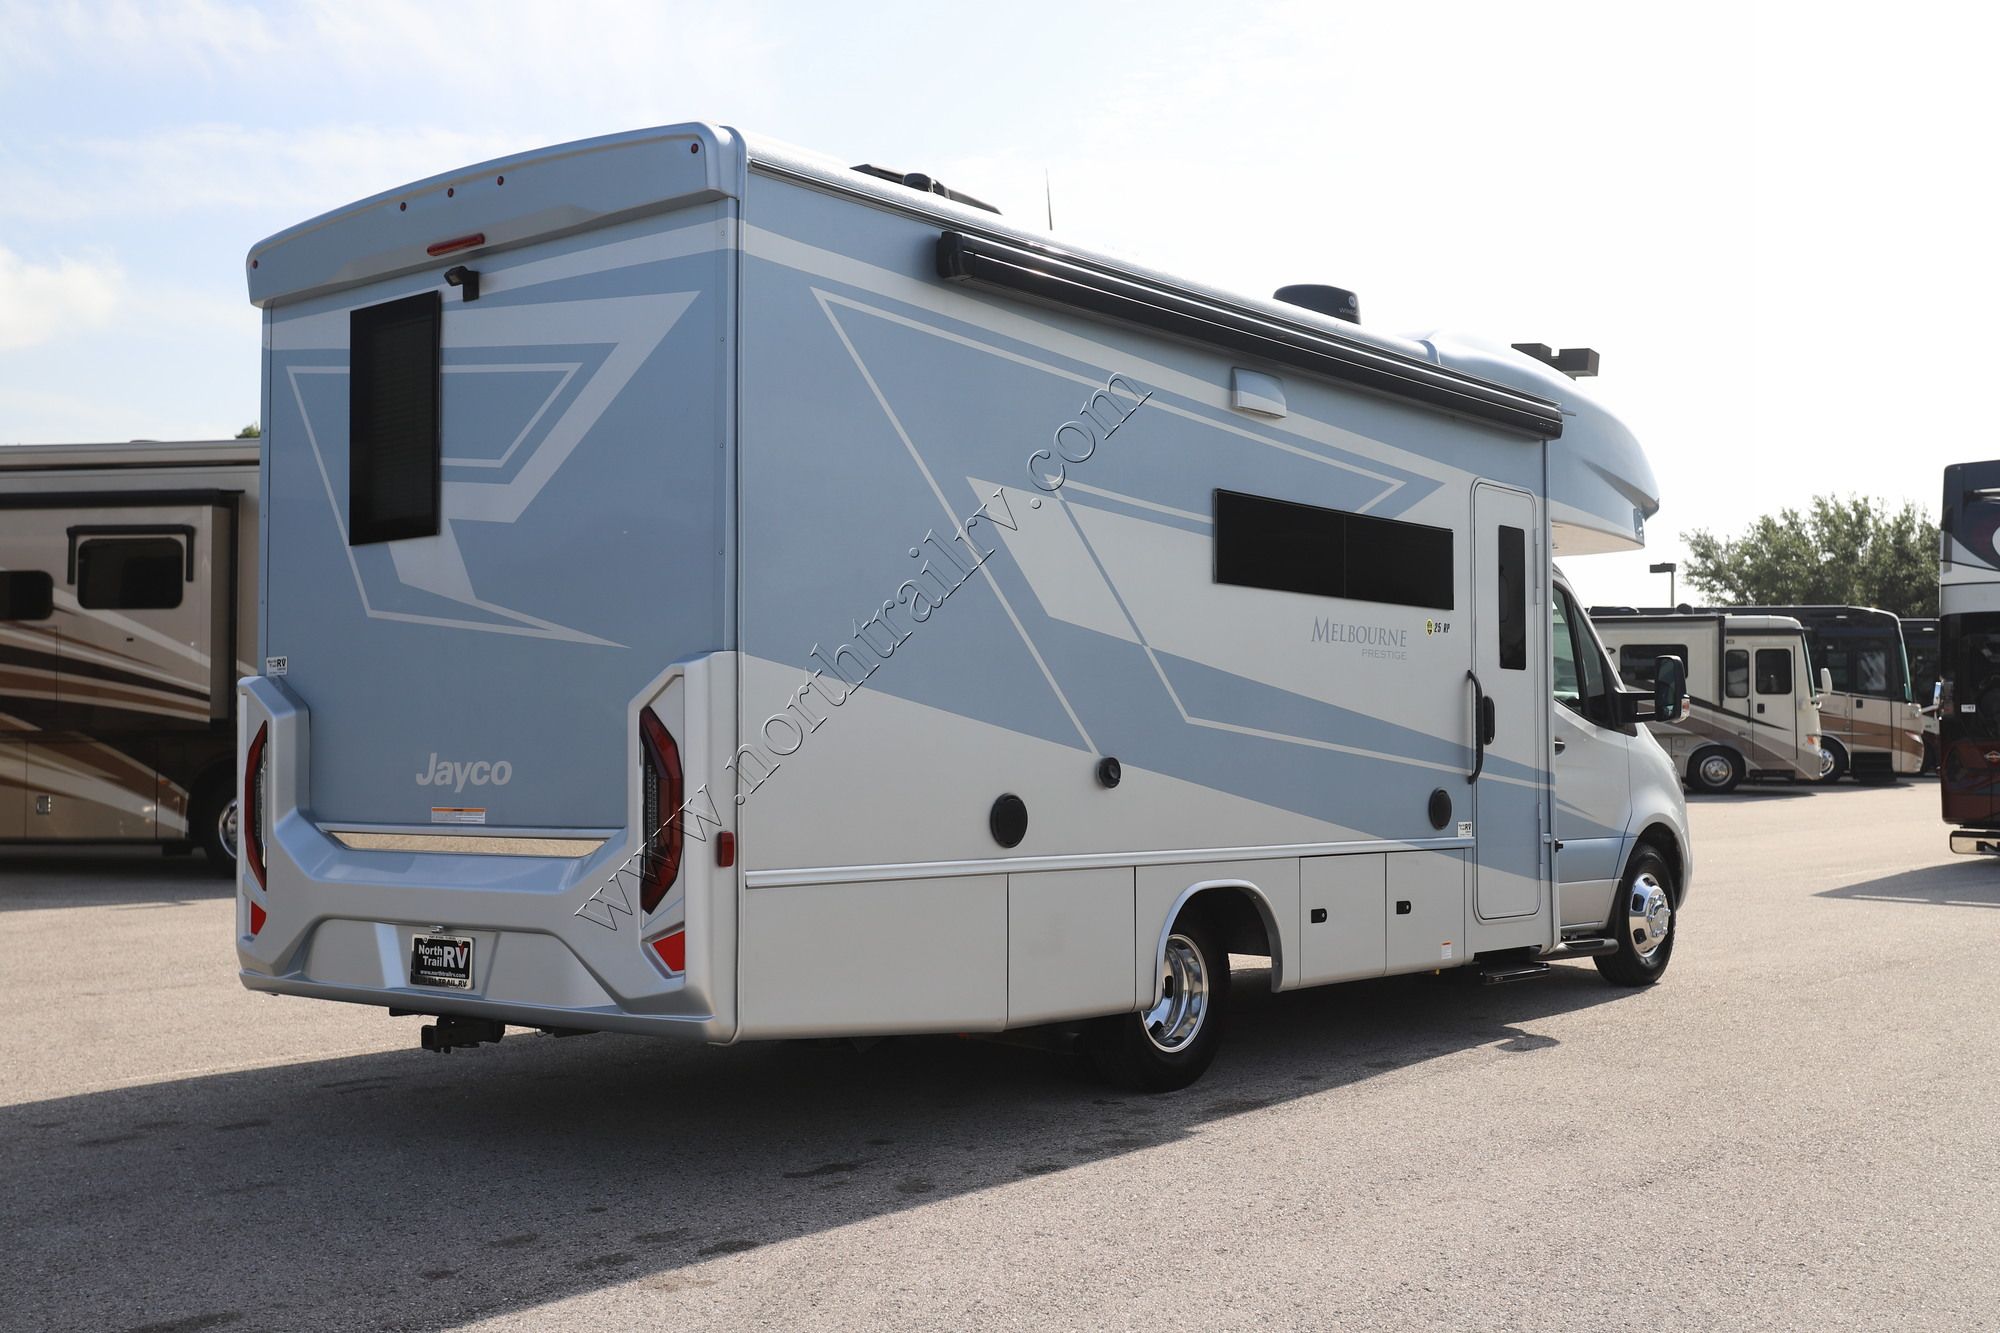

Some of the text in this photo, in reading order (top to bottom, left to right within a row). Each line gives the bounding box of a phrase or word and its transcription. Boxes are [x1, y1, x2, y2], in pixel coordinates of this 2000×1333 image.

[1361, 648, 1407, 661] PRESTIGE
[415, 752, 513, 793] Jayco
[418, 944, 443, 956] North
[423, 955, 443, 967] Trail
[443, 946, 469, 969] RV
